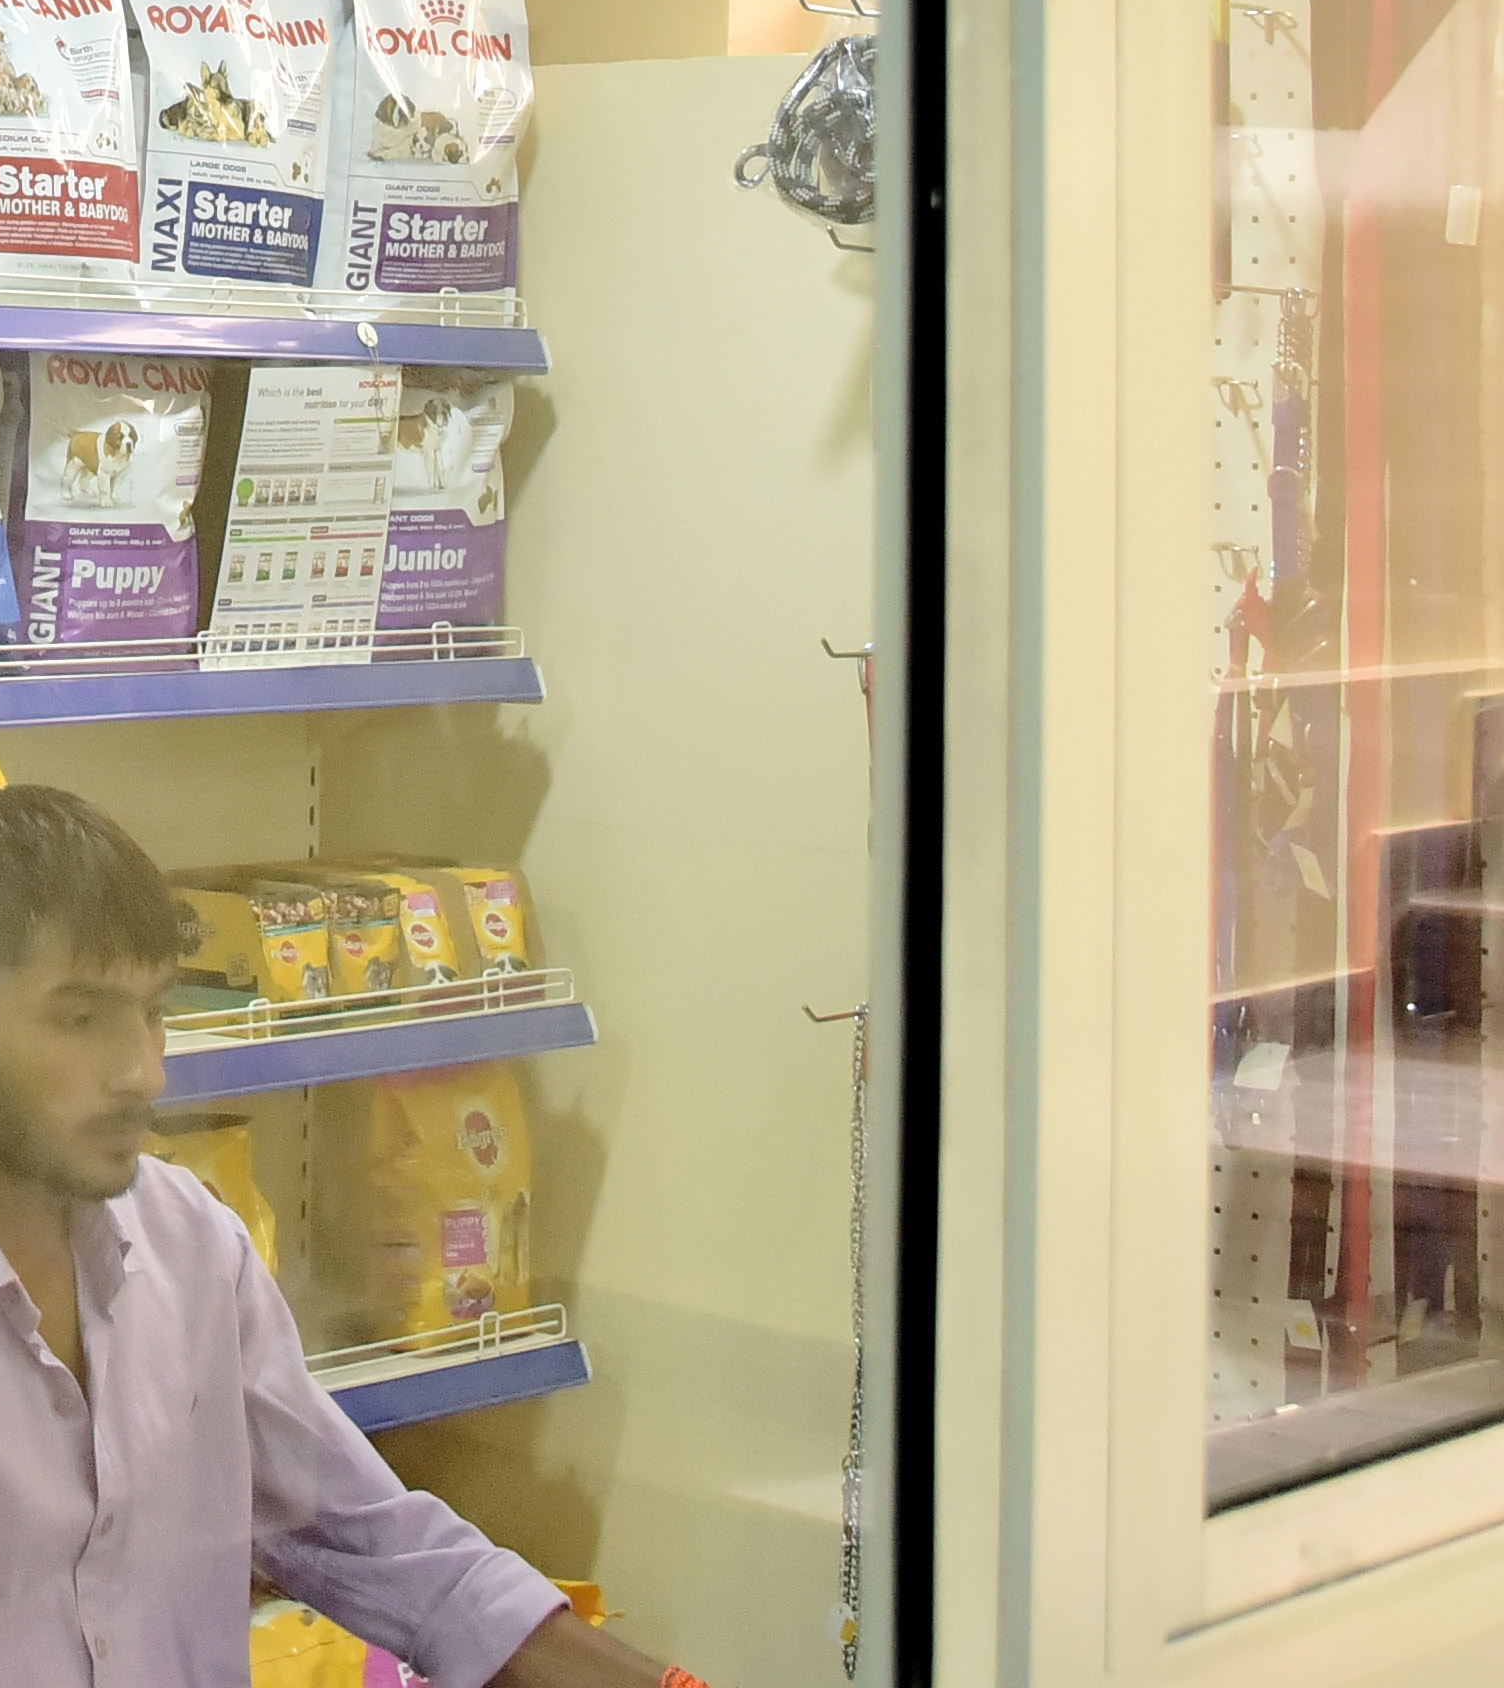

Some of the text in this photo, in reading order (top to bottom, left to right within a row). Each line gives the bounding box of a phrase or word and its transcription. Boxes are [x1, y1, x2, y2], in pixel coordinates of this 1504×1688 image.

[69, 45, 93, 56] Birth
[190, 161, 246, 172] LARGE DOGS
[64, 203, 75, 218] &
[193, 190, 292, 228] Starter
[152, 179, 182, 272] MAXI
[192, 222, 309, 249] MOTHER & BABYDOG
[387, 211, 489, 242] Starter
[346, 201, 377, 291] GIANT
[385, 242, 456, 258] MOTHER &
[47, 355, 138, 389] ROYAL
[258, 388, 322, 397] Which the best
[304, 401, 337, 409] nutrition
[69, 528, 130, 536] GIANT DOGS
[383, 544, 467, 572] Junior
[72, 559, 165, 594] Puppy
[28, 546, 62, 643] GIANT
